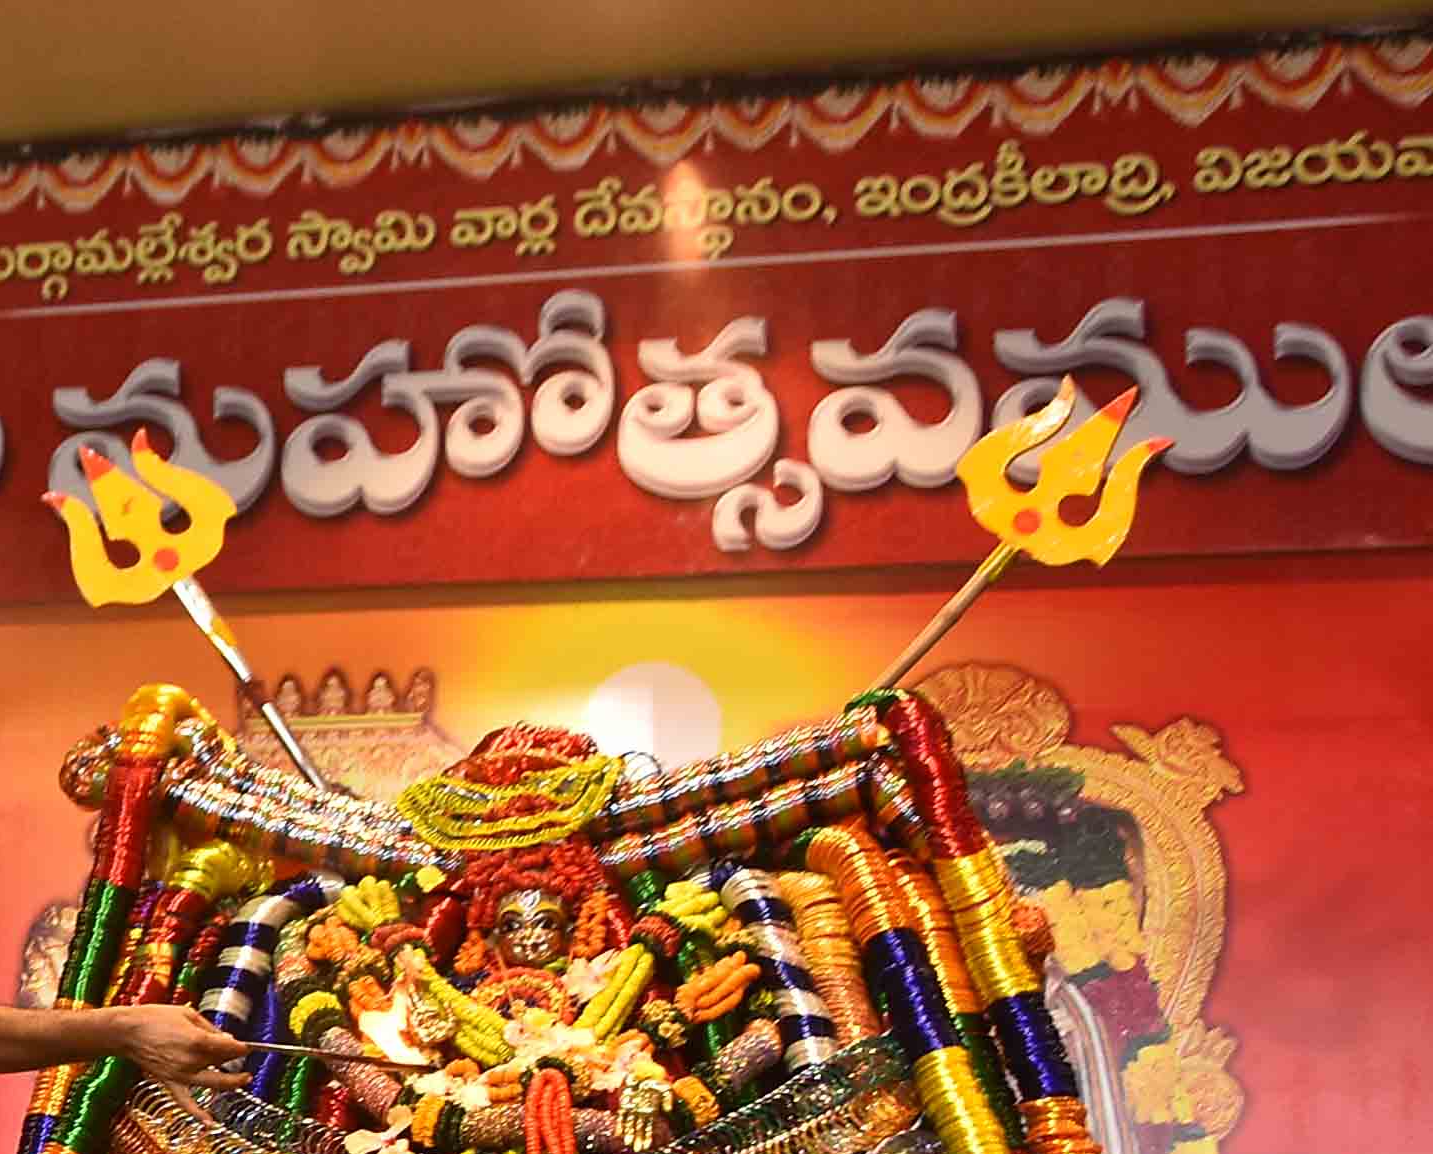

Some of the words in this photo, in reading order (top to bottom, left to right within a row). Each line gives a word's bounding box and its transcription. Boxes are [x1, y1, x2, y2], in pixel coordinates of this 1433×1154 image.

[286, 209, 436, 274] స్వామి
[450, 194, 558, 257] వార్ల
[854, 138, 1177, 226] ఇంద్రకీలాద్రి,
[1193, 128, 1433, 195] విజయవ
